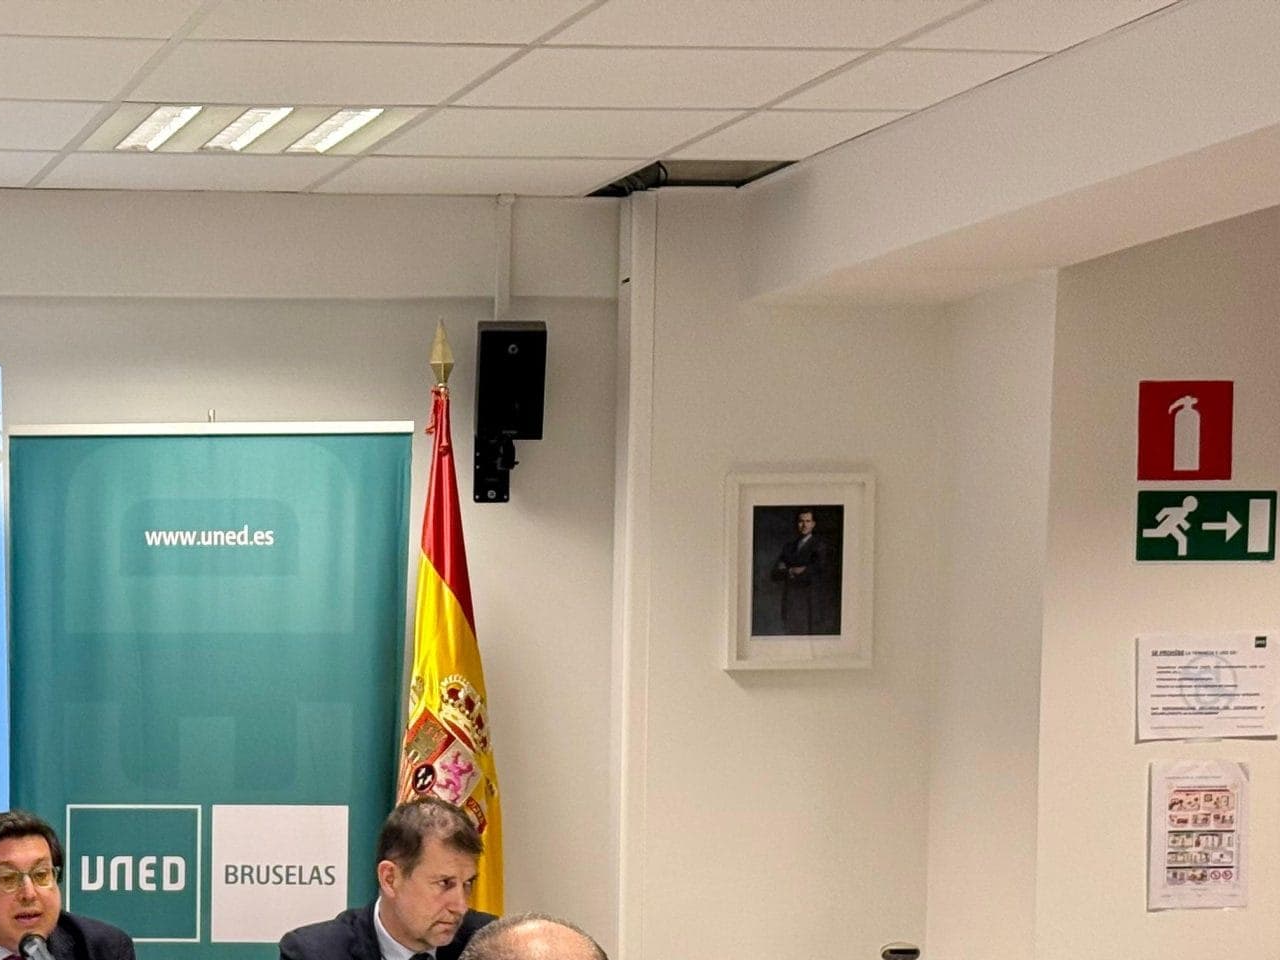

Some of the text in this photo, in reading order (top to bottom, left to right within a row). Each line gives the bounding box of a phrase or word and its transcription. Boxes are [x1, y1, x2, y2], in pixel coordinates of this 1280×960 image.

[144, 524, 274, 546] www.uned.es
[80, 855, 336, 891] UNED BRUSELAS
